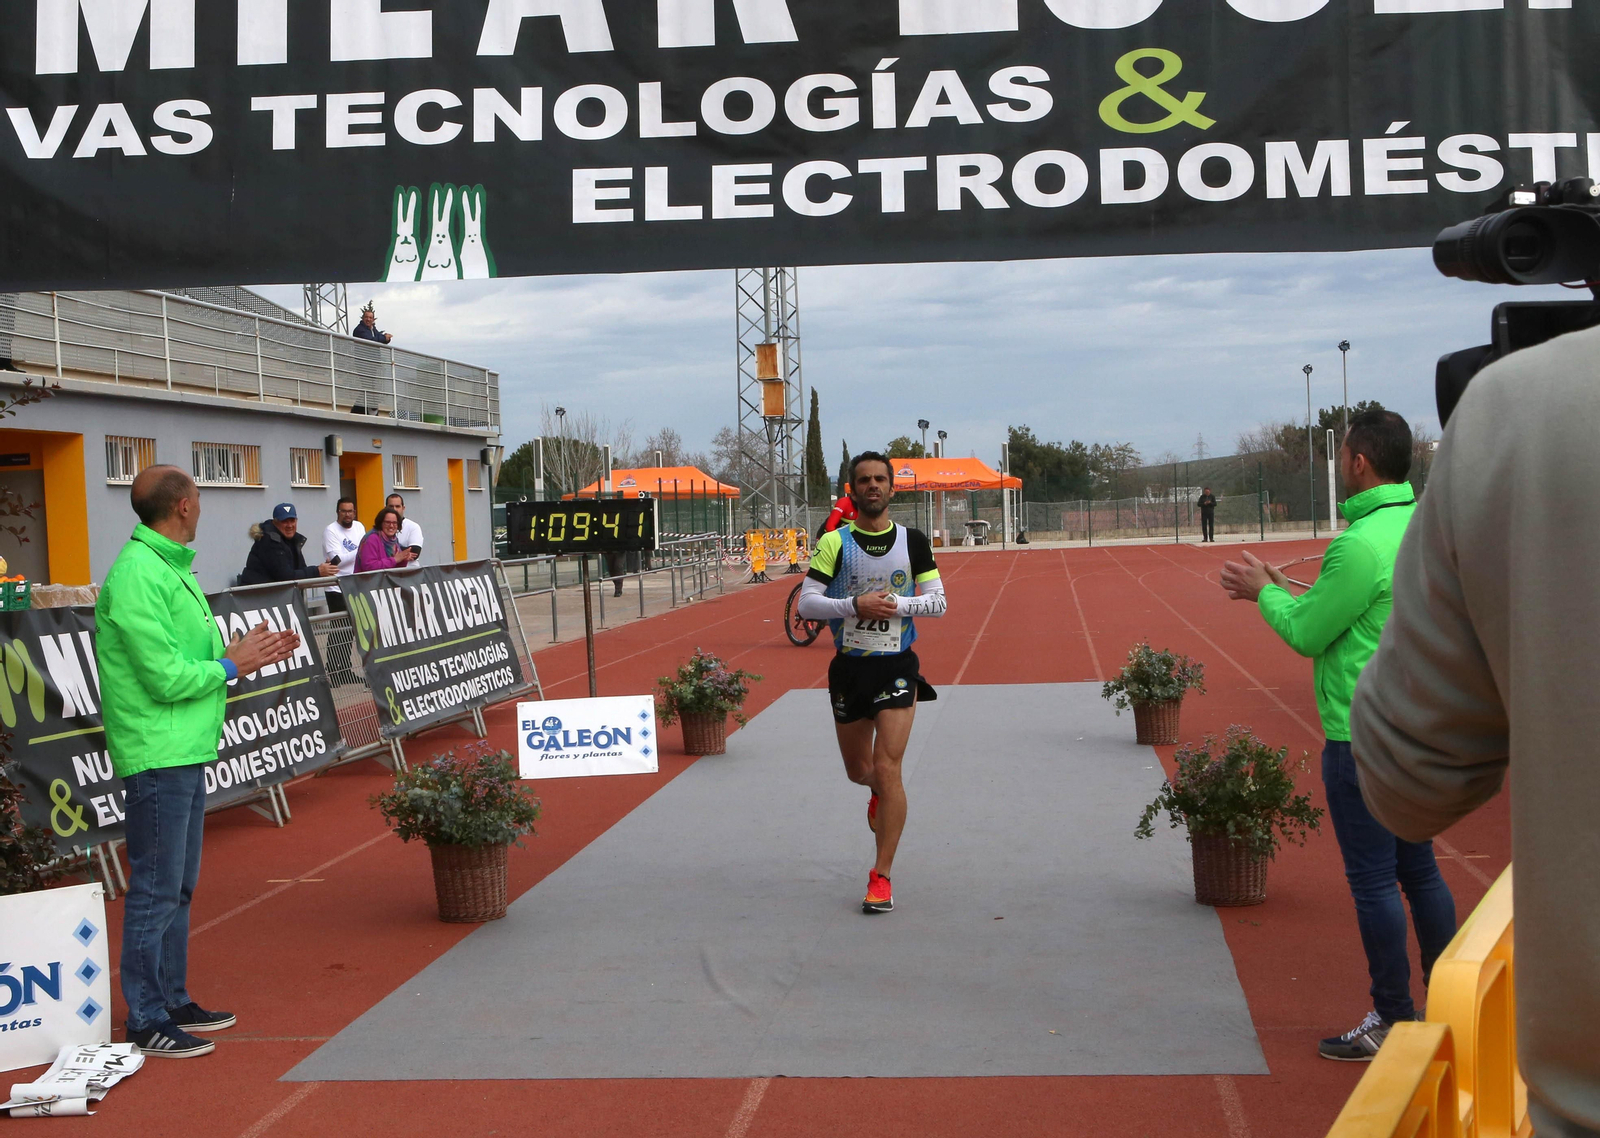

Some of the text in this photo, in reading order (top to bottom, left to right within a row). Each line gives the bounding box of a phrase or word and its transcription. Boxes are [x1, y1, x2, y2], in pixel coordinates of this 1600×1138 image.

[6, 47, 1217, 160] VAS TECNOLOGÍAS &
[530, 511, 644, 542] 1:09:41
[370, 574, 504, 648] MILAR LUCENA
[391, 641, 510, 693] NUEVAS TECNOLOGÍAS
[385, 665, 515, 725] & ELECTRODOMESTICOS
[522, 720, 541, 731] EL
[526, 725, 632, 751] GALEÓN
[539, 753, 570, 761] flores
[582, 751, 623, 760] plantas
[49, 778, 89, 837] &
